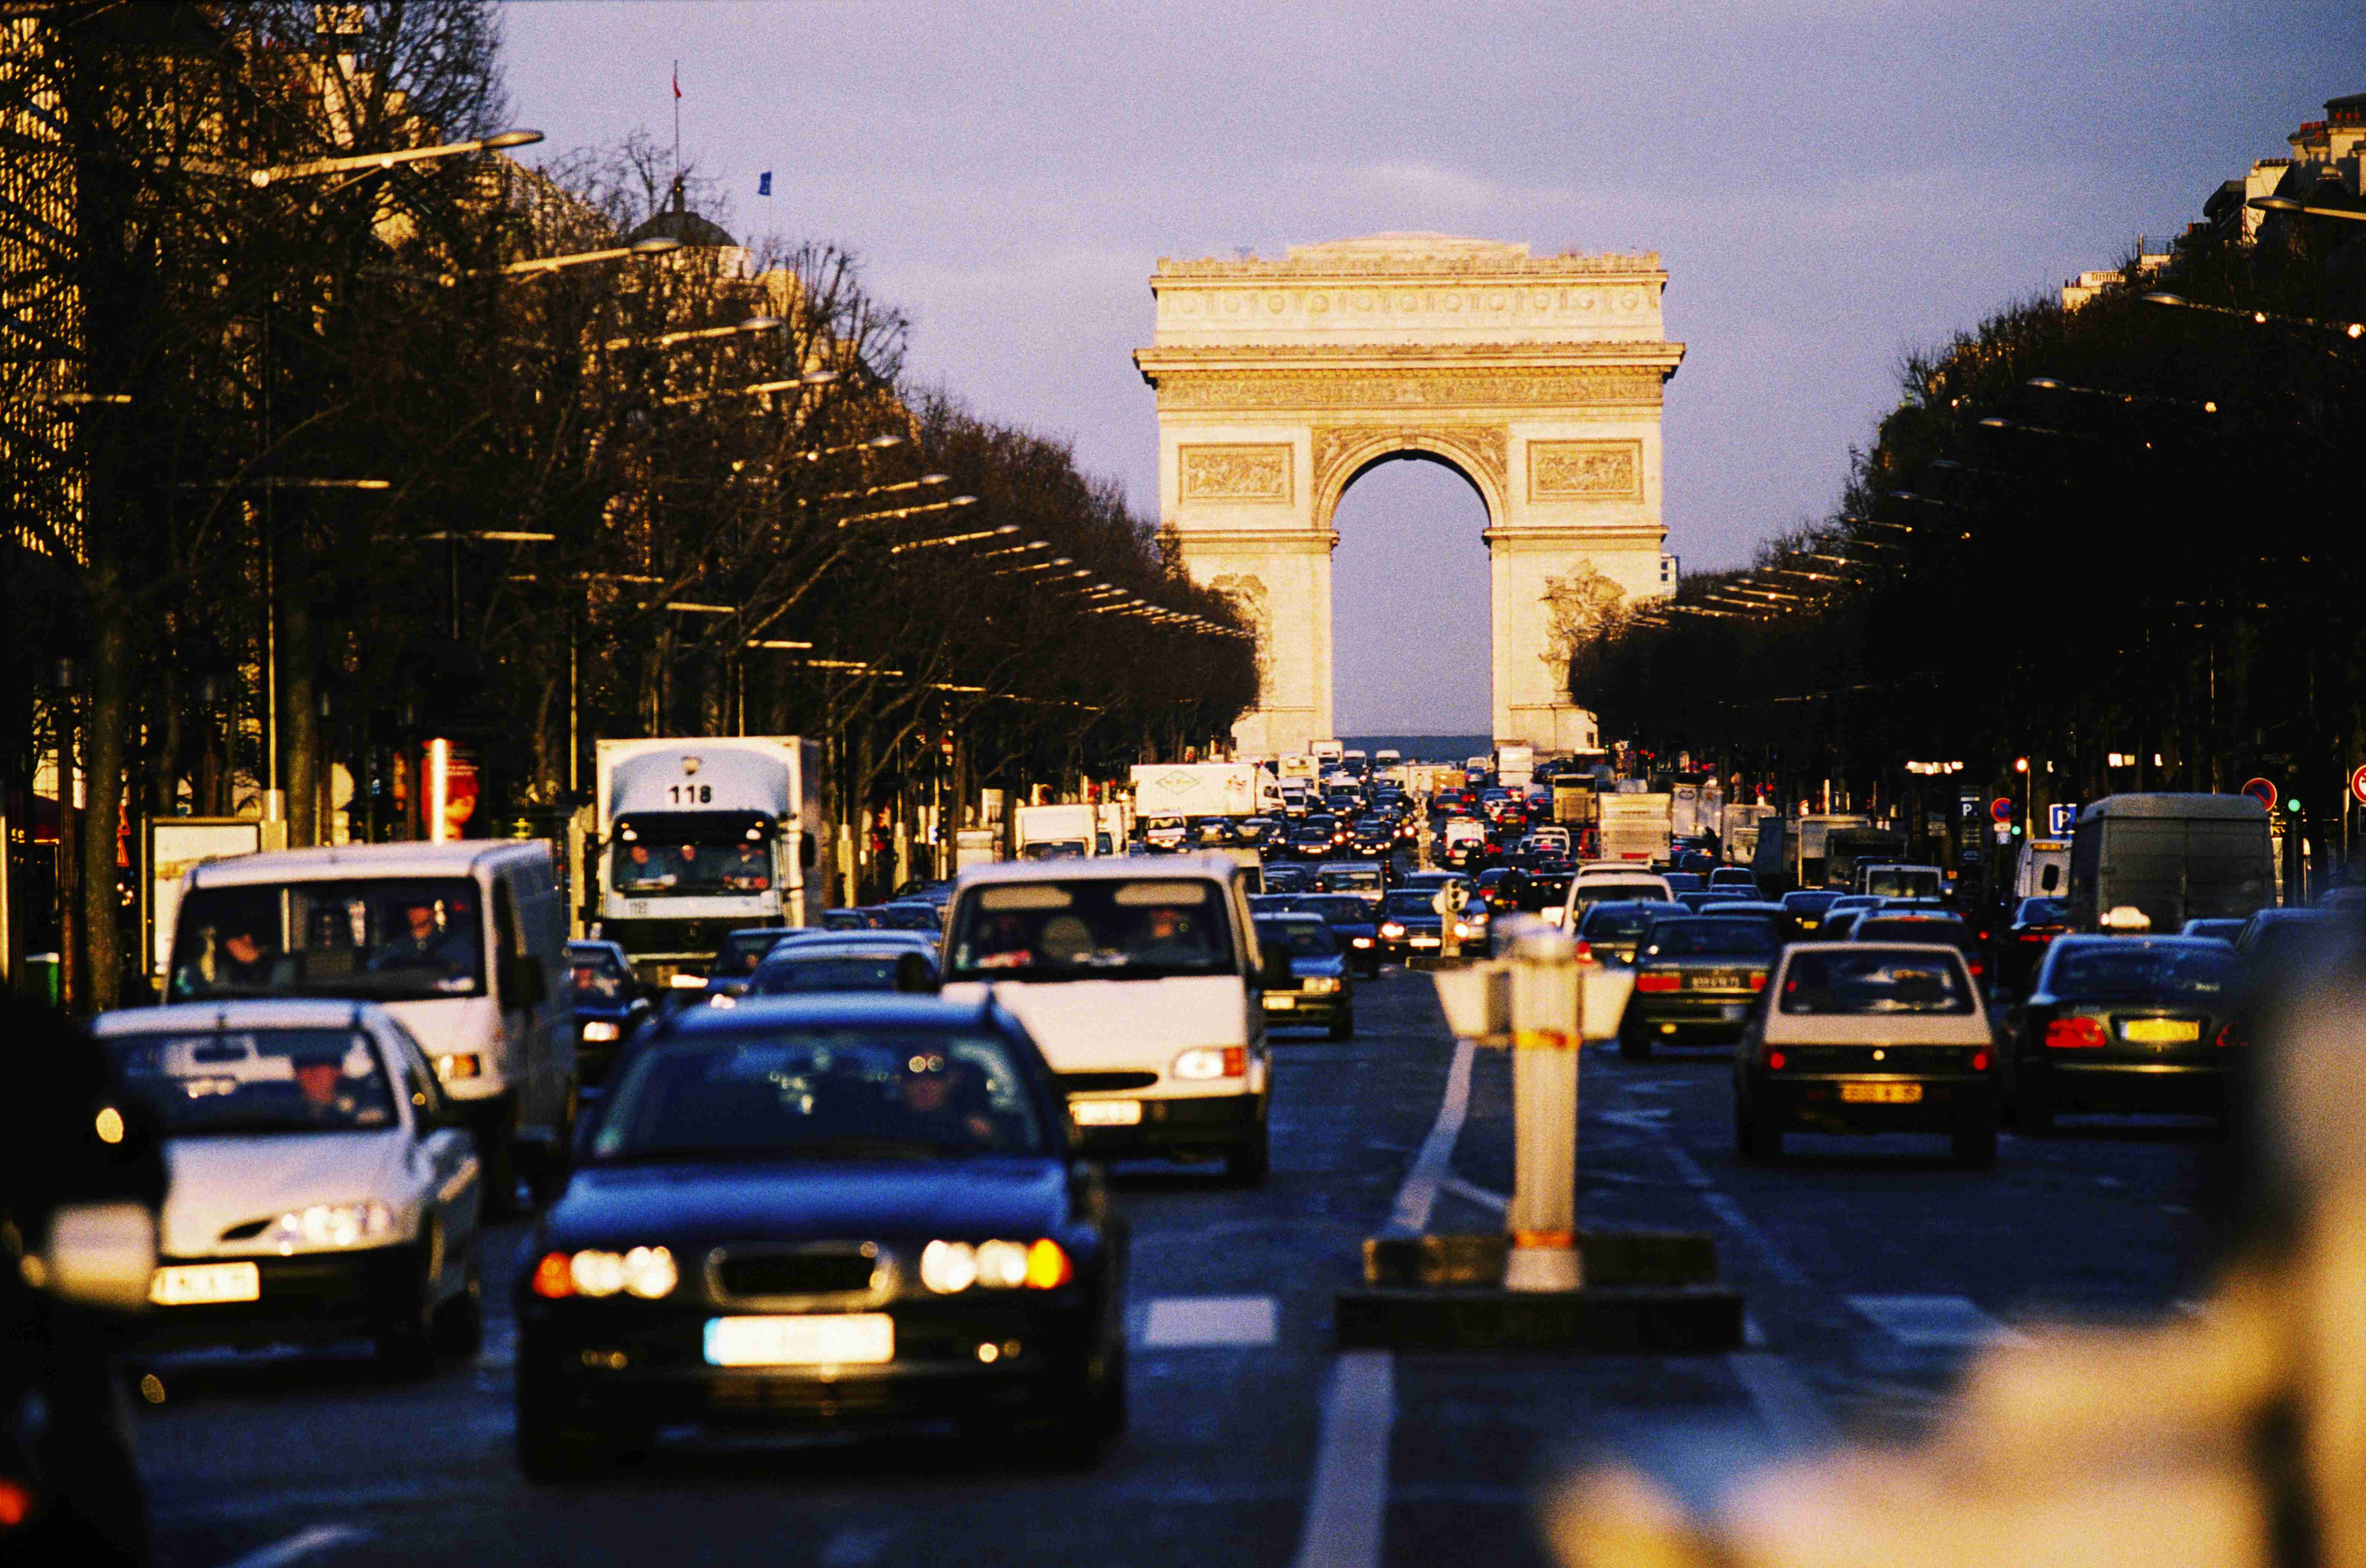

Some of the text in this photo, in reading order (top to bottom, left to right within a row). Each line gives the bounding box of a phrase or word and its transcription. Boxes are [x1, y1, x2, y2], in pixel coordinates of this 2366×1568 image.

[669, 785, 711, 803] 118
[1963, 803, 1972, 817] P
[2058, 810, 2071, 828] P
